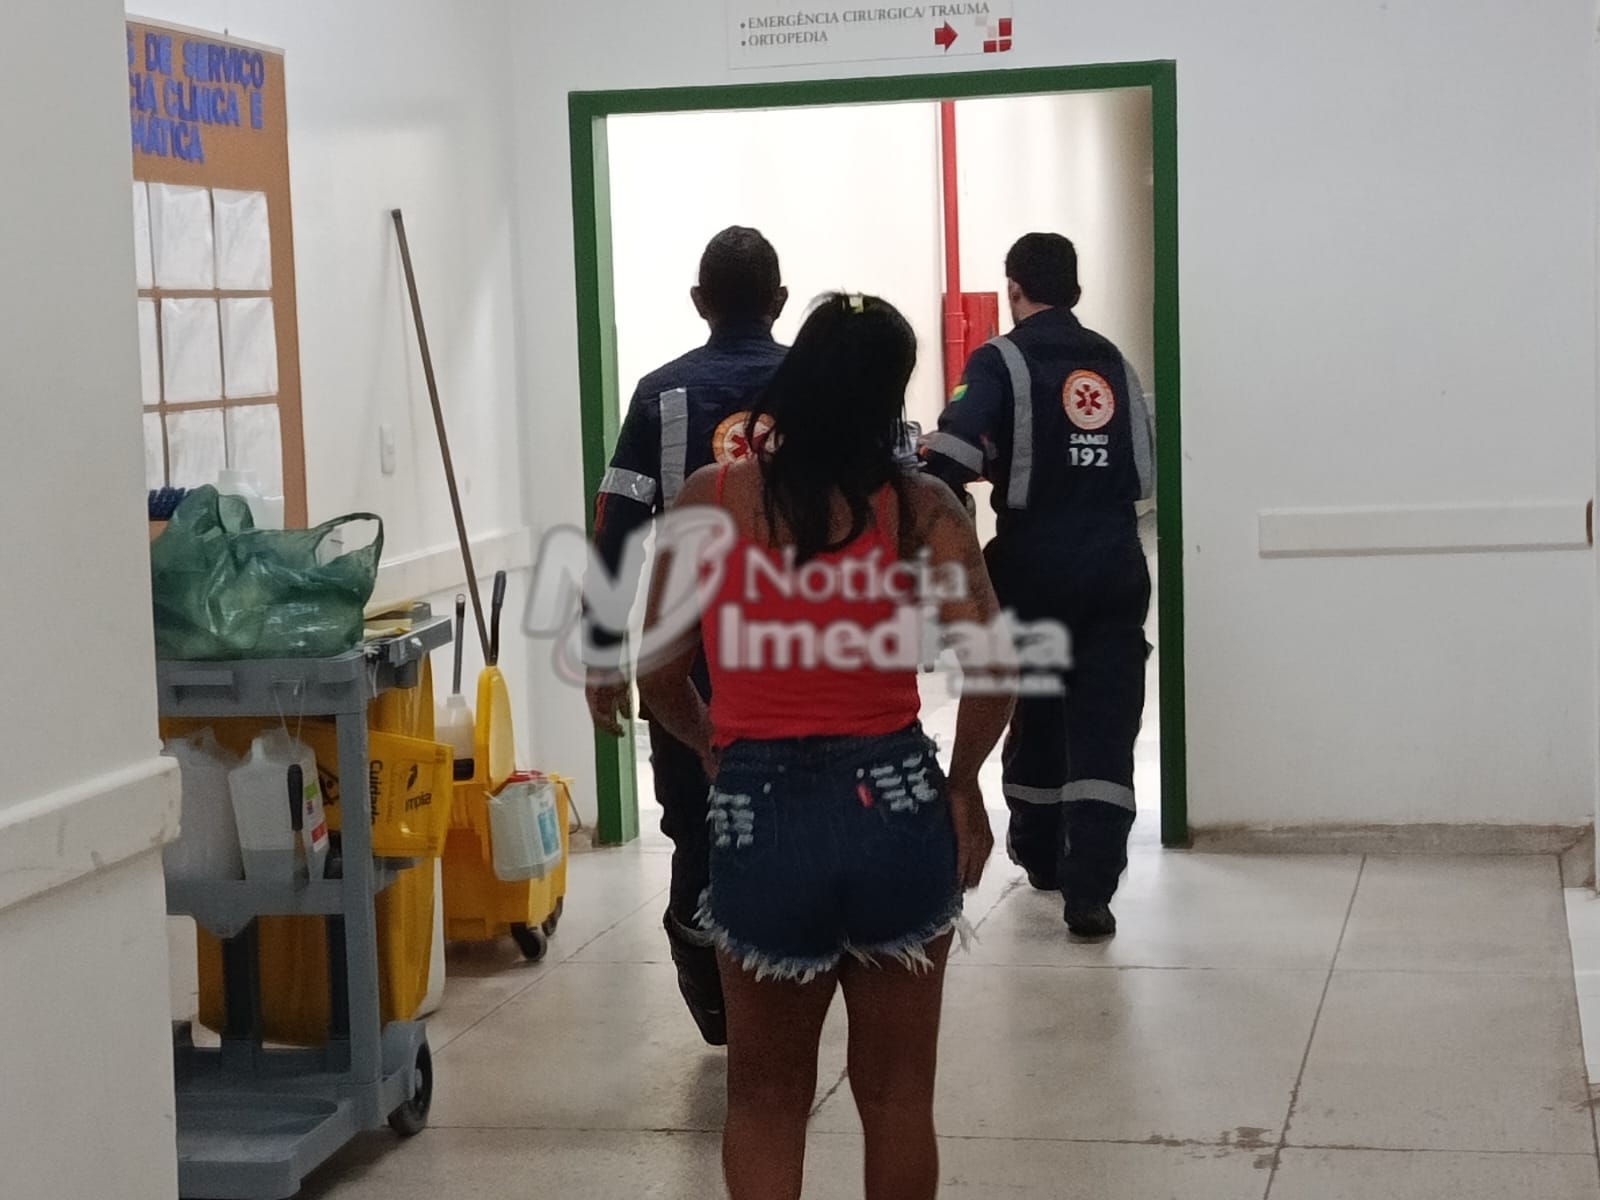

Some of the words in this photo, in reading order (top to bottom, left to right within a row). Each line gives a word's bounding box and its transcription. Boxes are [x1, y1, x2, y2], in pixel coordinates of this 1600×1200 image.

[747, 10, 840, 29] EMERGÊNCIA
[929, 2, 990, 17] TRAUMA
[748, 30, 829, 46] ORTOPEDIA
[145, 33, 173, 75] DE
[1068, 447, 1111, 467] 192
